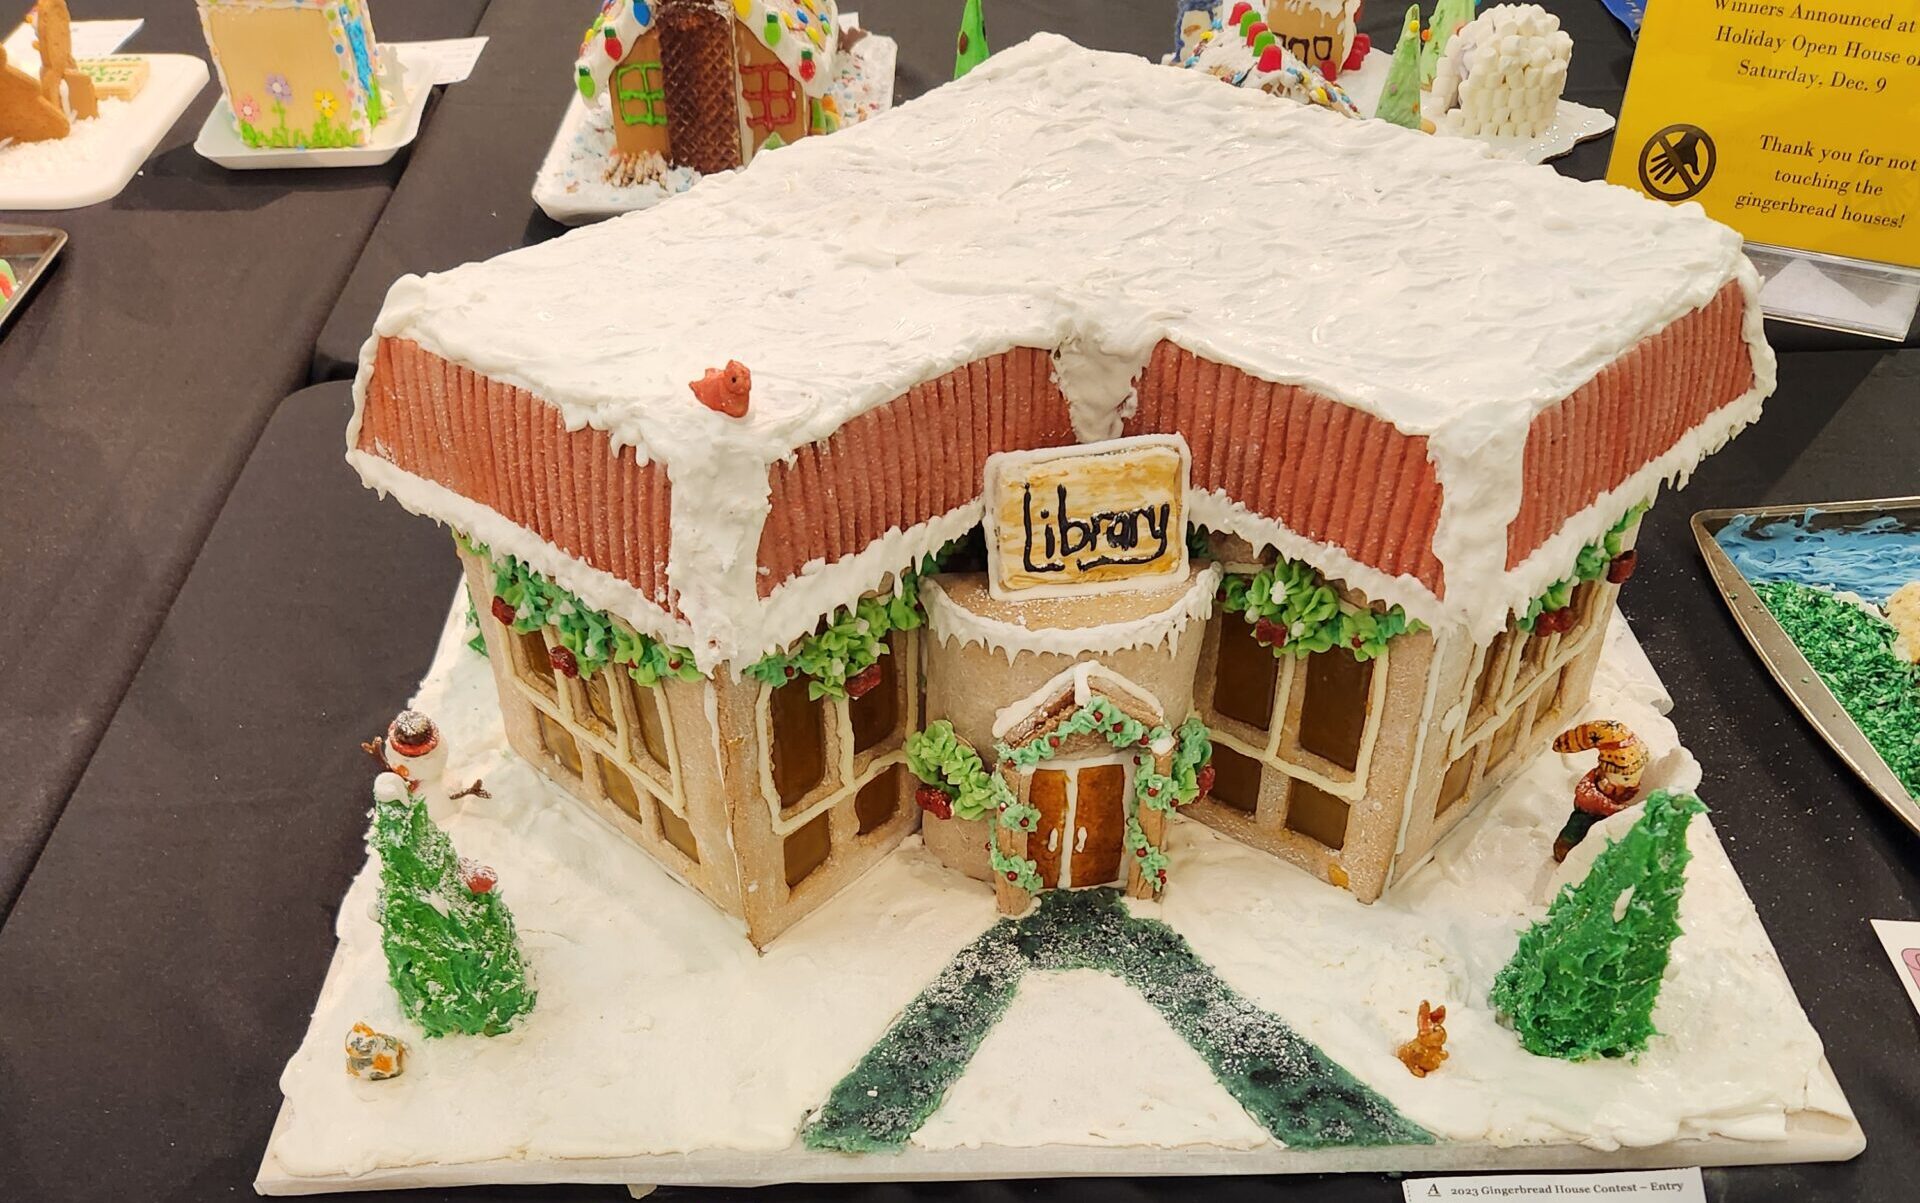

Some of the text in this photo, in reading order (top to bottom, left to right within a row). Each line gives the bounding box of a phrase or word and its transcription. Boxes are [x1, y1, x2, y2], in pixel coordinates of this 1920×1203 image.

[1715, 0, 1916, 33] Winners Announced at
[1715, 25, 1786, 53] Holiday
[1792, 34, 1838, 58] Open
[1844, 41, 1900, 64] House
[1831, 71, 1869, 92] Dec.
[1875, 77, 1887, 93] 9
[1760, 134, 1917, 172] Thank you for not
[1775, 169, 1883, 196] touching the
[1735, 191, 1906, 229] gingerbread houses!
[1427, 1183, 1441, 1197] A
[1450, 1187, 1479, 1197] 2023
[1481, 1185, 1553, 1197] Gingerbread
[1555, 1184, 1591, 1194] House
[1593, 1184, 1638, 1194] Contest
[1650, 1181, 1684, 1193] Entry
